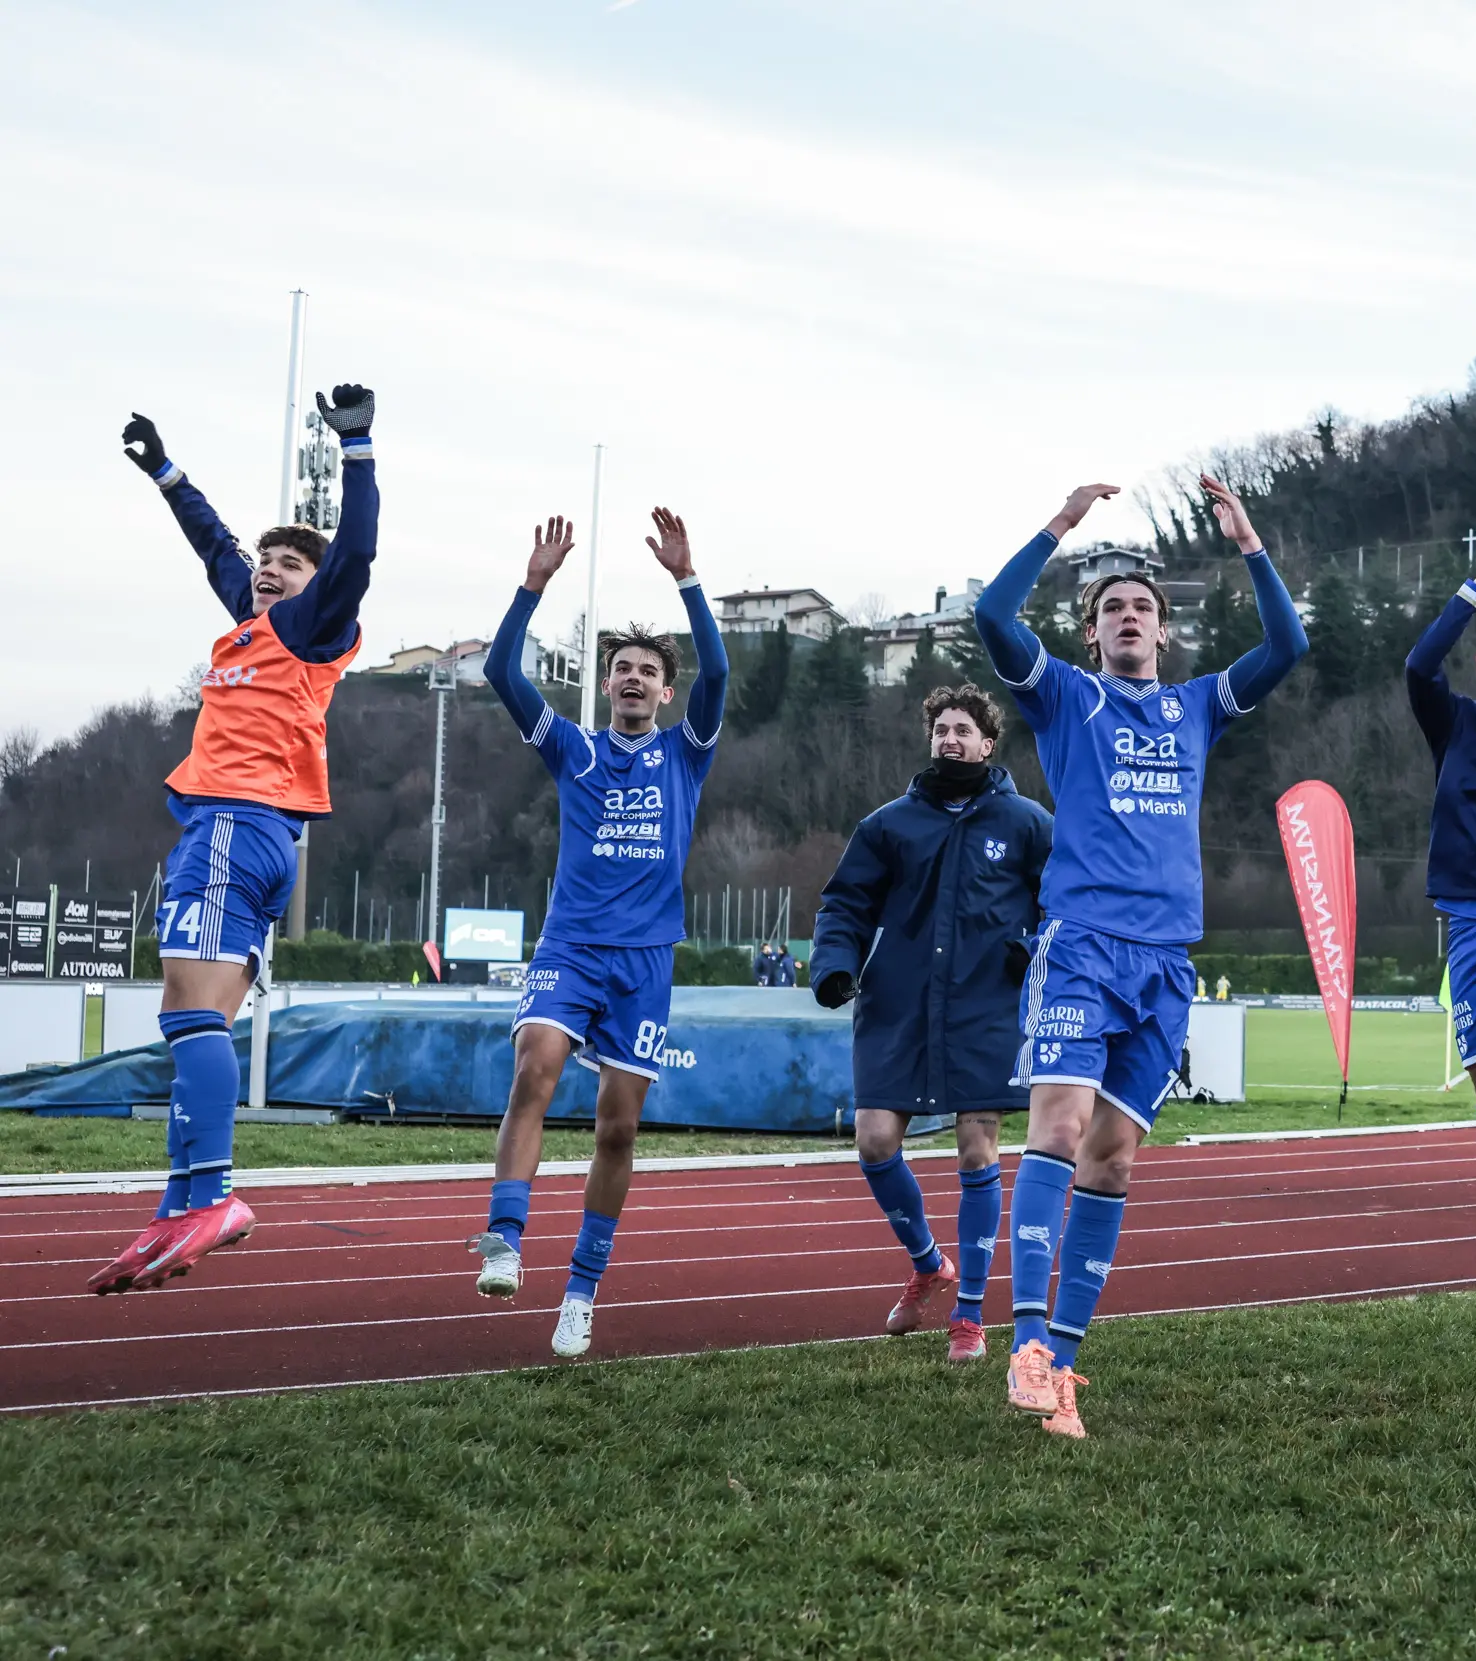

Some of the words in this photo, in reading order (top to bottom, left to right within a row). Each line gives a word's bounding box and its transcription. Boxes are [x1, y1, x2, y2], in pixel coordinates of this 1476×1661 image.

[1114, 727, 1177, 758] a2a
[1115, 756, 1134, 765] LIFE
[604, 785, 664, 811] a2a
[622, 811, 663, 820] COMPANY
[1139, 798, 1187, 816] Marsh
[618, 844, 665, 860] Marsh
[161, 900, 202, 944] 74
[60, 961, 125, 978] AUTOVEGA
[527, 970, 560, 980] ARDA
[527, 980, 556, 991] UBE
[1354, 1001, 1408, 1009] DATACOL
[1453, 1000, 1473, 1017] RDA
[1038, 1006, 1085, 1024] GARDA
[1453, 1013, 1474, 1031] UBE
[1036, 1022, 1083, 1039] STUBE
[633, 1020, 668, 1066] 82
